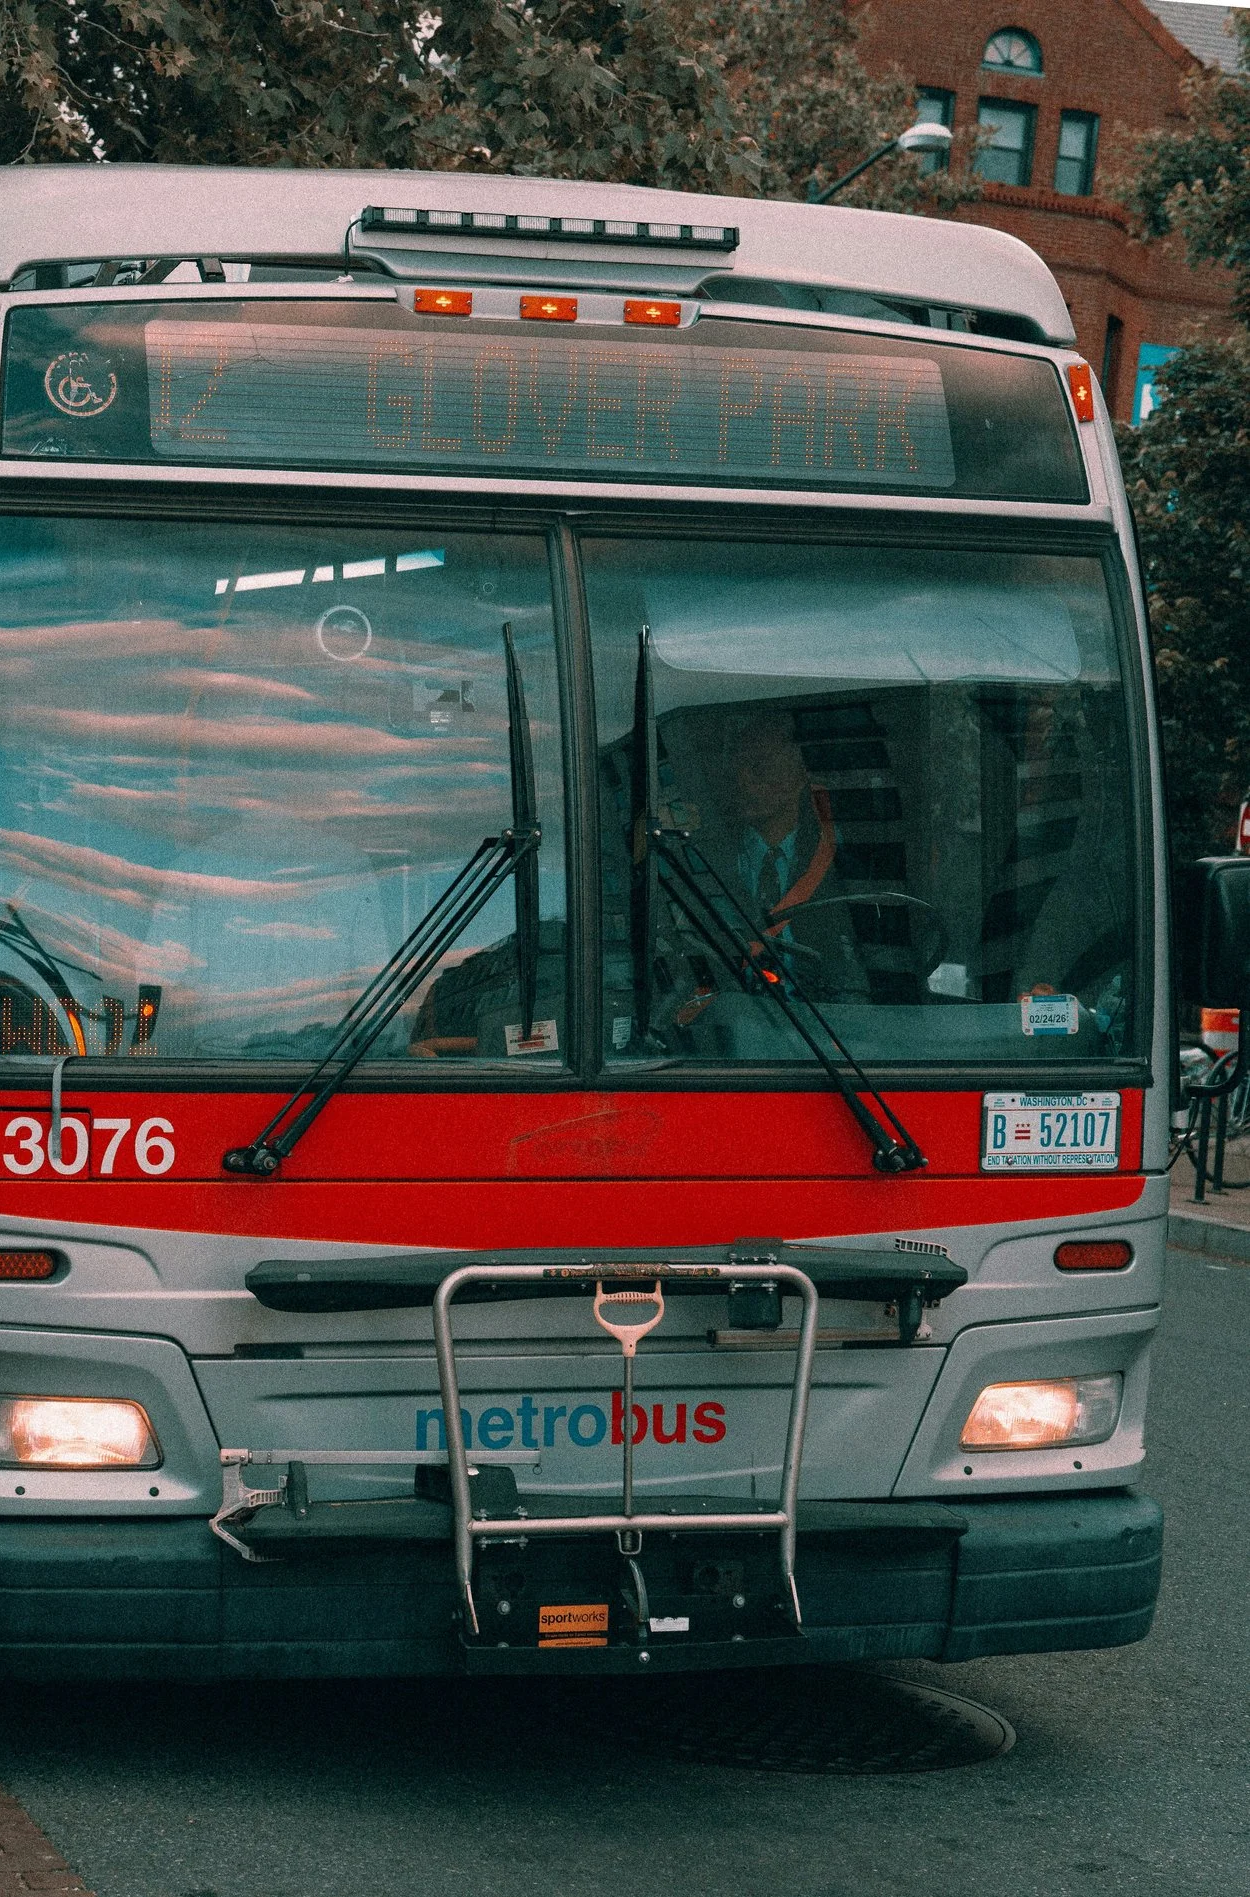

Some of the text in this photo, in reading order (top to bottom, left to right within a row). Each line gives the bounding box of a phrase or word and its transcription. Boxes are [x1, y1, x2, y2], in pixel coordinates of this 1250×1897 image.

[366, 340, 681, 460] GLOVER
[718, 355, 921, 472] PARK
[1029, 1014, 1067, 1024] 02/24/26
[1020, 1096, 1088, 1107] WASHINGTON, DC
[993, 1112, 1110, 1149] B 52107
[3, 1116, 175, 1175] 3076
[987, 1155, 1000, 1166] END
[1032, 1154, 1061, 1165] WITHOUT
[416, 1391, 727, 1450] metrobus
[541, 1610, 606, 1626] sportworks
